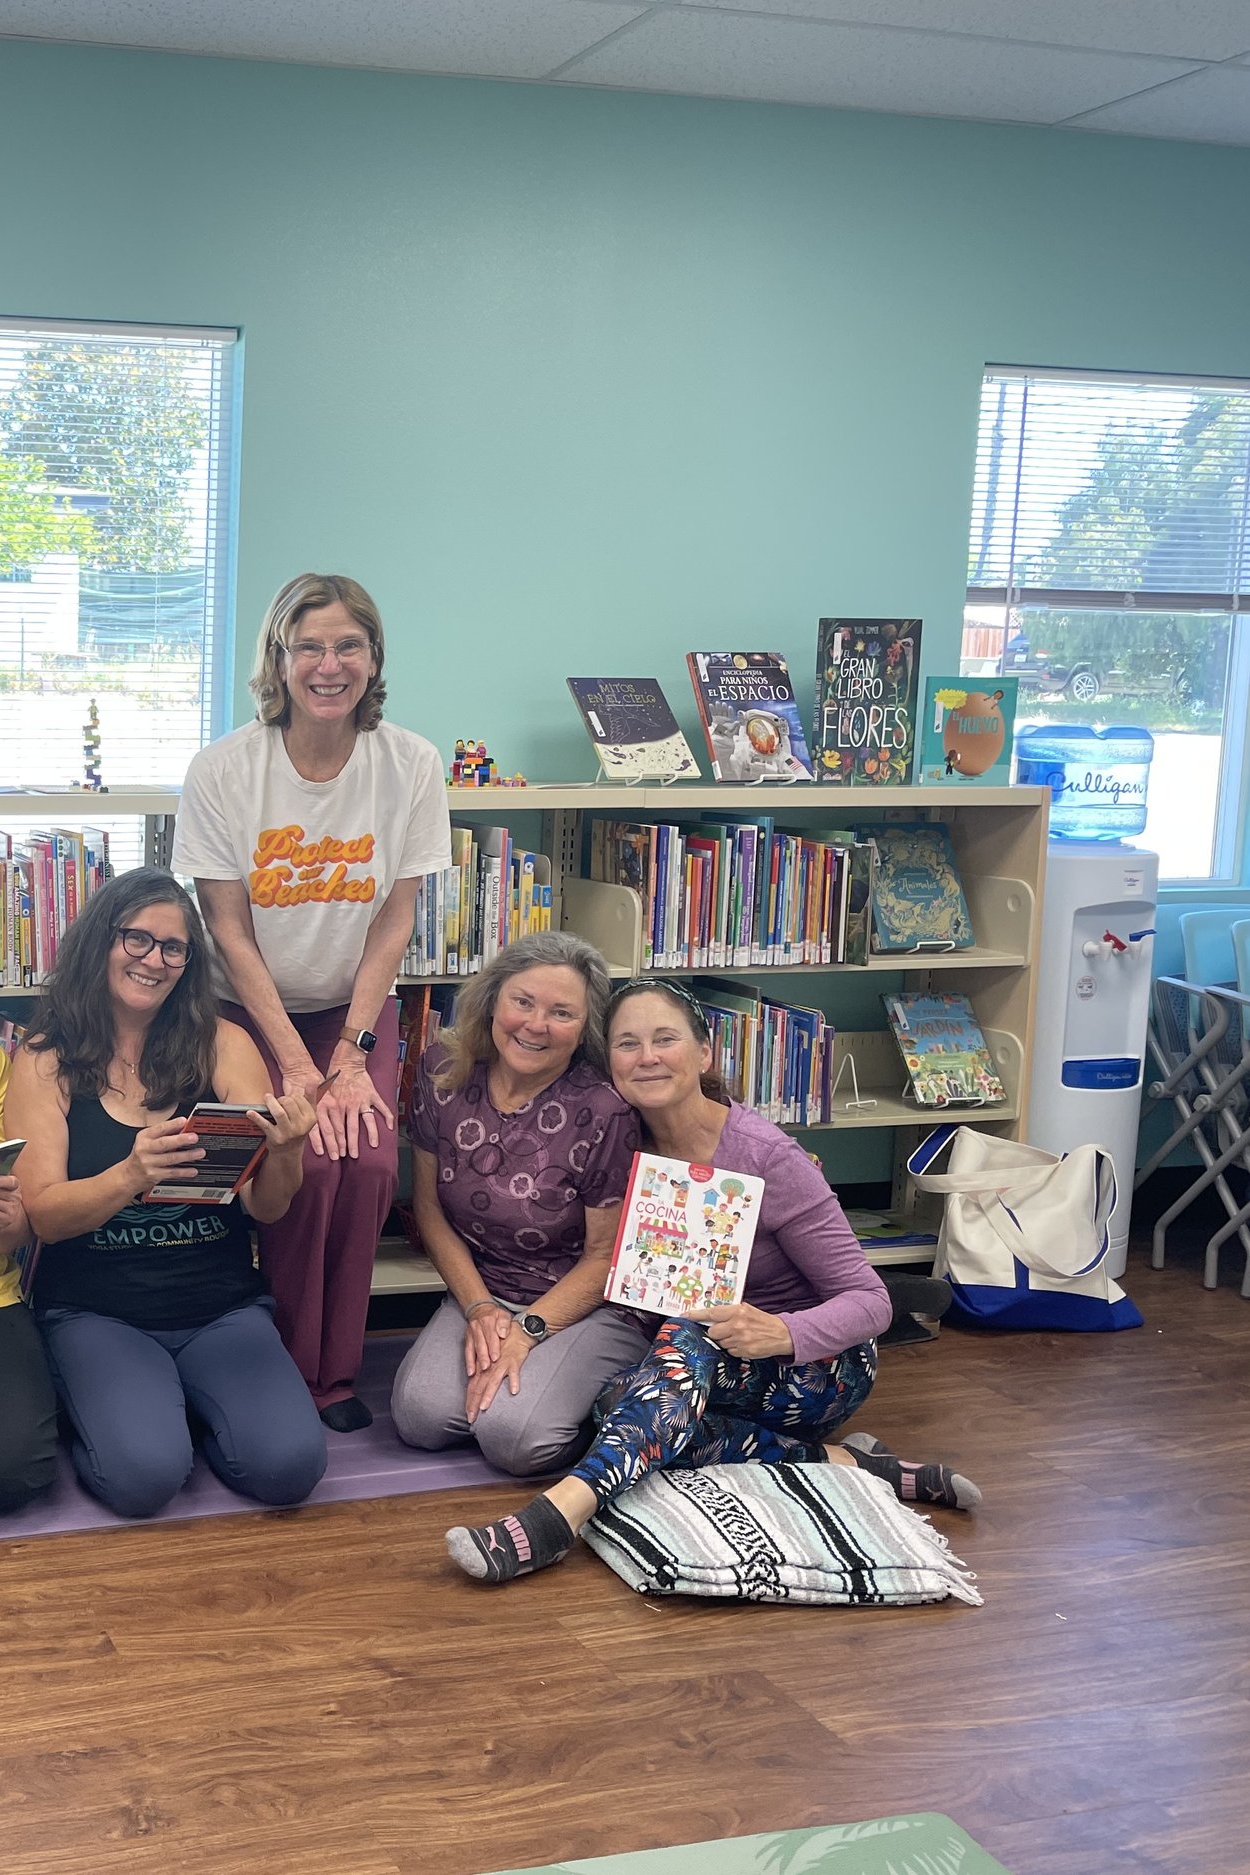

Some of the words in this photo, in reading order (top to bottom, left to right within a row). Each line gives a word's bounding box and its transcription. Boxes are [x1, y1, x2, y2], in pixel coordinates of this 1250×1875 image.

[840, 658, 876, 678] GRAN
[599, 683, 635, 693] MITOS
[720, 676, 742, 684] PARA
[742, 675, 768, 685] NIÑOS
[837, 678, 883, 699] LIBRO
[587, 693, 602, 703] EN
[606, 693, 621, 703] EL
[708, 689, 718, 697] EL
[718, 685, 789, 701] ESPACIO
[822, 706, 908, 749] FLORES
[1045, 771, 1144, 804] Culligan
[253, 824, 375, 869] Protect
[248, 863, 376, 908] Beaches
[491, 876, 500, 910] Outside
[898, 877, 938, 894] Animales
[635, 1201, 688, 1223] COCINA
[93, 1215, 225, 1244] EMPOWER
